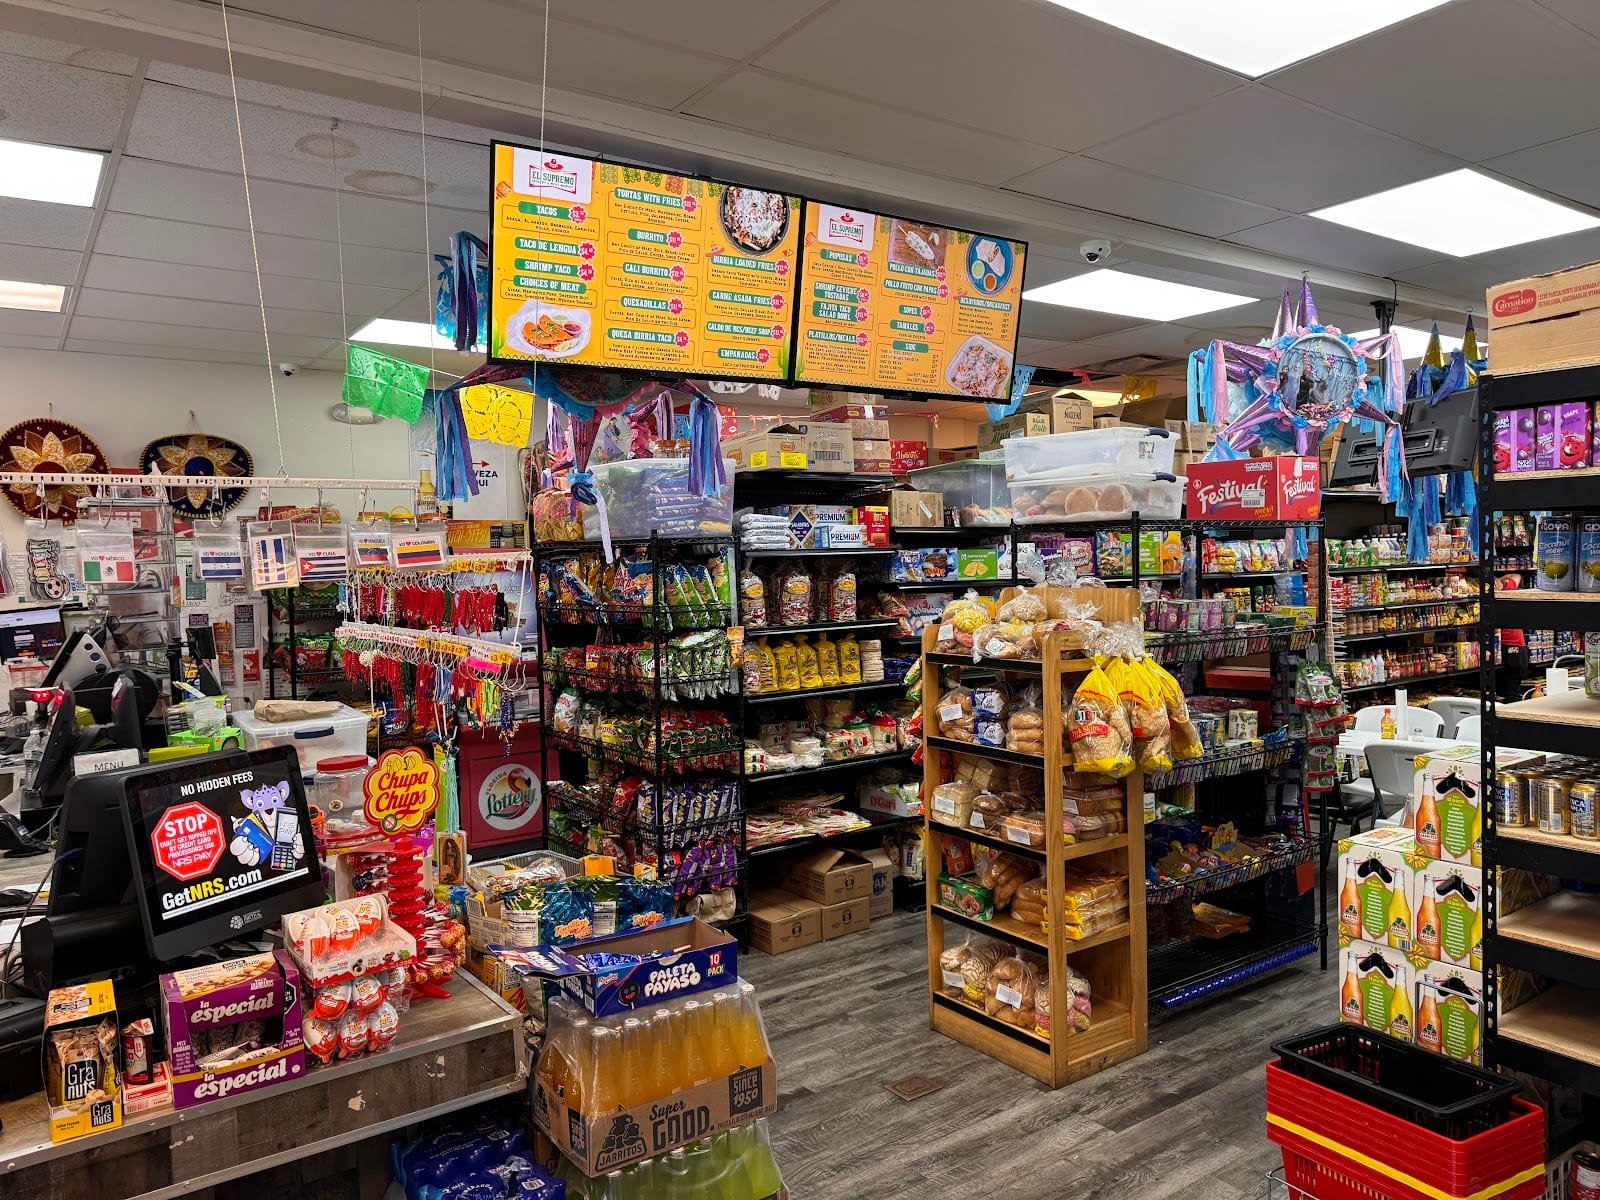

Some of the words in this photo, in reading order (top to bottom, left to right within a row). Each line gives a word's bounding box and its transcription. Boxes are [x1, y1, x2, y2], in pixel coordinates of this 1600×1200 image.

[543, 172, 575, 185] SUPREMO
[617, 188, 641, 200] TORTAS
[643, 191, 661, 203] WITH
[662, 195, 681, 207] FRIES
[536, 205, 558, 217] TACOS
[637, 231, 664, 242] BURRITO
[519, 239, 537, 248] TACO
[538, 241, 547, 250] DE
[549, 243, 577, 254] LENGUA
[713, 255, 733, 265] BIRRIA
[735, 258, 757, 269] LOADED
[757, 261, 774, 271] FRIES
[829, 251, 852, 262] PUPUSAS
[525, 261, 553, 272] SHRIMP
[555, 264, 571, 275] TACO
[625, 263, 640, 273] CALI
[642, 266, 669, 278] BURRITO
[889, 262, 905, 273] POLLO
[519, 277, 548, 288] CHOICES
[550, 280, 559, 289] OF
[561, 282, 581, 292] MEAT
[815, 281, 835, 291] SHRIMP
[885, 279, 900, 288] POLLO
[623, 297, 667, 310] QUESADILLAS
[712, 291, 732, 301] CARNE
[733, 294, 752, 303] ASADA
[753, 296, 770, 306] FRIES
[1495, 294, 1534, 313] Carnation
[818, 309, 836, 319] SALAD
[839, 304, 852, 313] TACO
[707, 322, 724, 331] CALDO
[896, 321, 919, 331] TAMALES
[611, 329, 632, 339] QUESA
[633, 331, 656, 341] BIRRIA
[658, 333, 672, 342] TACO
[808, 330, 856, 343] PLATILLOS/MEALS
[720, 349, 756, 360] EMPANADAS
[1563, 409, 1579, 418] GRAPE
[1197, 474, 1264, 514] Festival
[1283, 475, 1316, 504] Festival
[816, 512, 846, 522] PREMIUM
[831, 532, 860, 541] PREMIUM
[1540, 522, 1570, 531] GOYA
[1584, 523, 1600, 532] GO
[1539, 540, 1570, 550] Coconut
[1582, 542, 1600, 551] Coco
[1546, 546, 1564, 555] Water
[94, 760, 124, 771] MENU
[180, 783, 195, 797] NO
[196, 776, 231, 793] HIDDEN
[232, 771, 254, 785] FEES
[378, 770, 429, 794] Chupa
[485, 771, 508, 795] FLORIDA
[375, 788, 427, 814] Chups
[486, 787, 536, 820] Lottery
[870, 795, 896, 810] D'Gari
[164, 813, 208, 838] STOP
[279, 827, 295, 835] PAY
[159, 838, 177, 849] DON'T
[188, 831, 207, 841] RIPPED
[168, 845, 177, 853] BY
[177, 841, 196, 850] CREDIT
[197, 836, 212, 845] CARD
[172, 856, 193, 868] NRS
[193, 850, 214, 862] PAY
[162, 868, 263, 911] GetNRS.com
[709, 953, 720, 965] 10
[649, 962, 696, 983] PALETA
[707, 964, 725, 977] PACK
[644, 972, 701, 997] PAYASO
[190, 991, 275, 1024] especial
[200, 1000, 210, 1009] la
[67, 1064, 95, 1087] Gra
[194, 1057, 288, 1099] especial
[204, 1072, 215, 1082] la
[67, 1081, 97, 1100] nuts
[733, 1087, 759, 1108] 1950
[92, 1103, 112, 1118] Gra
[648, 1100, 686, 1121] Super
[93, 1114, 113, 1127] nuts
[652, 1105, 715, 1151] GOOD.
[599, 1143, 642, 1166] JARRITOS
